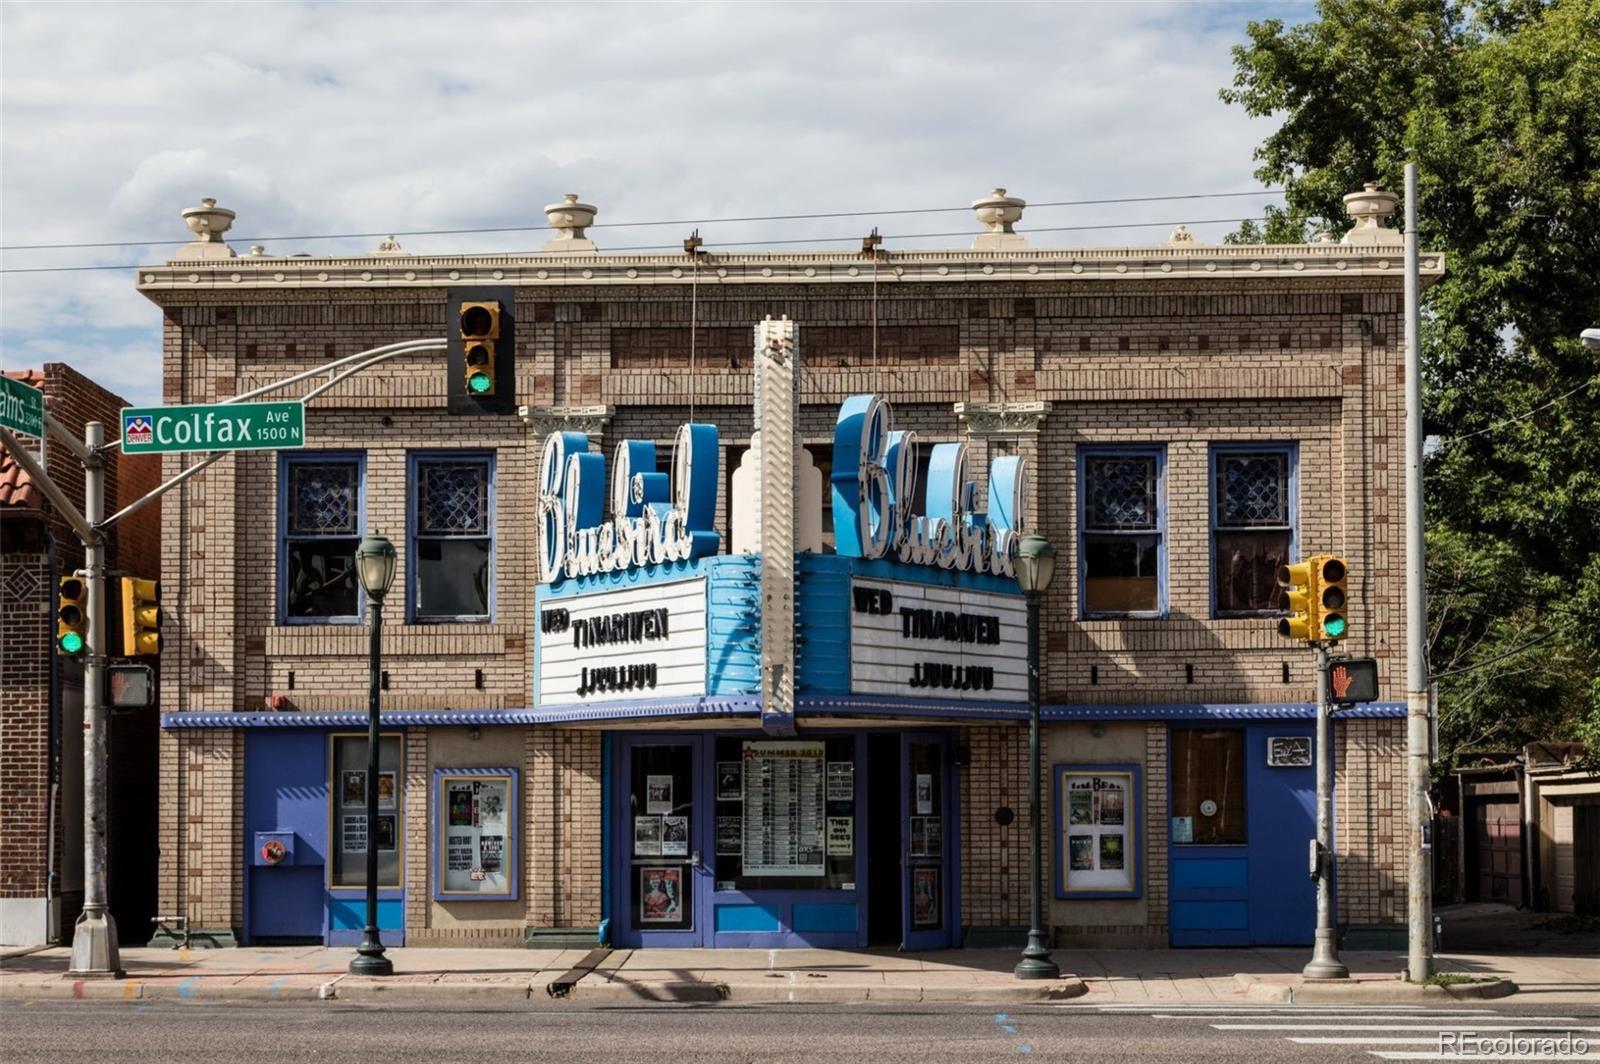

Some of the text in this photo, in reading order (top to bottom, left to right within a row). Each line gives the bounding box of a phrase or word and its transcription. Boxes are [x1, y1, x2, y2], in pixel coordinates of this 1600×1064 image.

[127, 432, 152, 443] DENVER
[157, 411, 289, 444] Colfax Ave
[257, 427, 299, 440] 1500 N
[571, 607, 669, 650] TINARIWEN
[853, 586, 1000, 646] WED TINARIWEN
